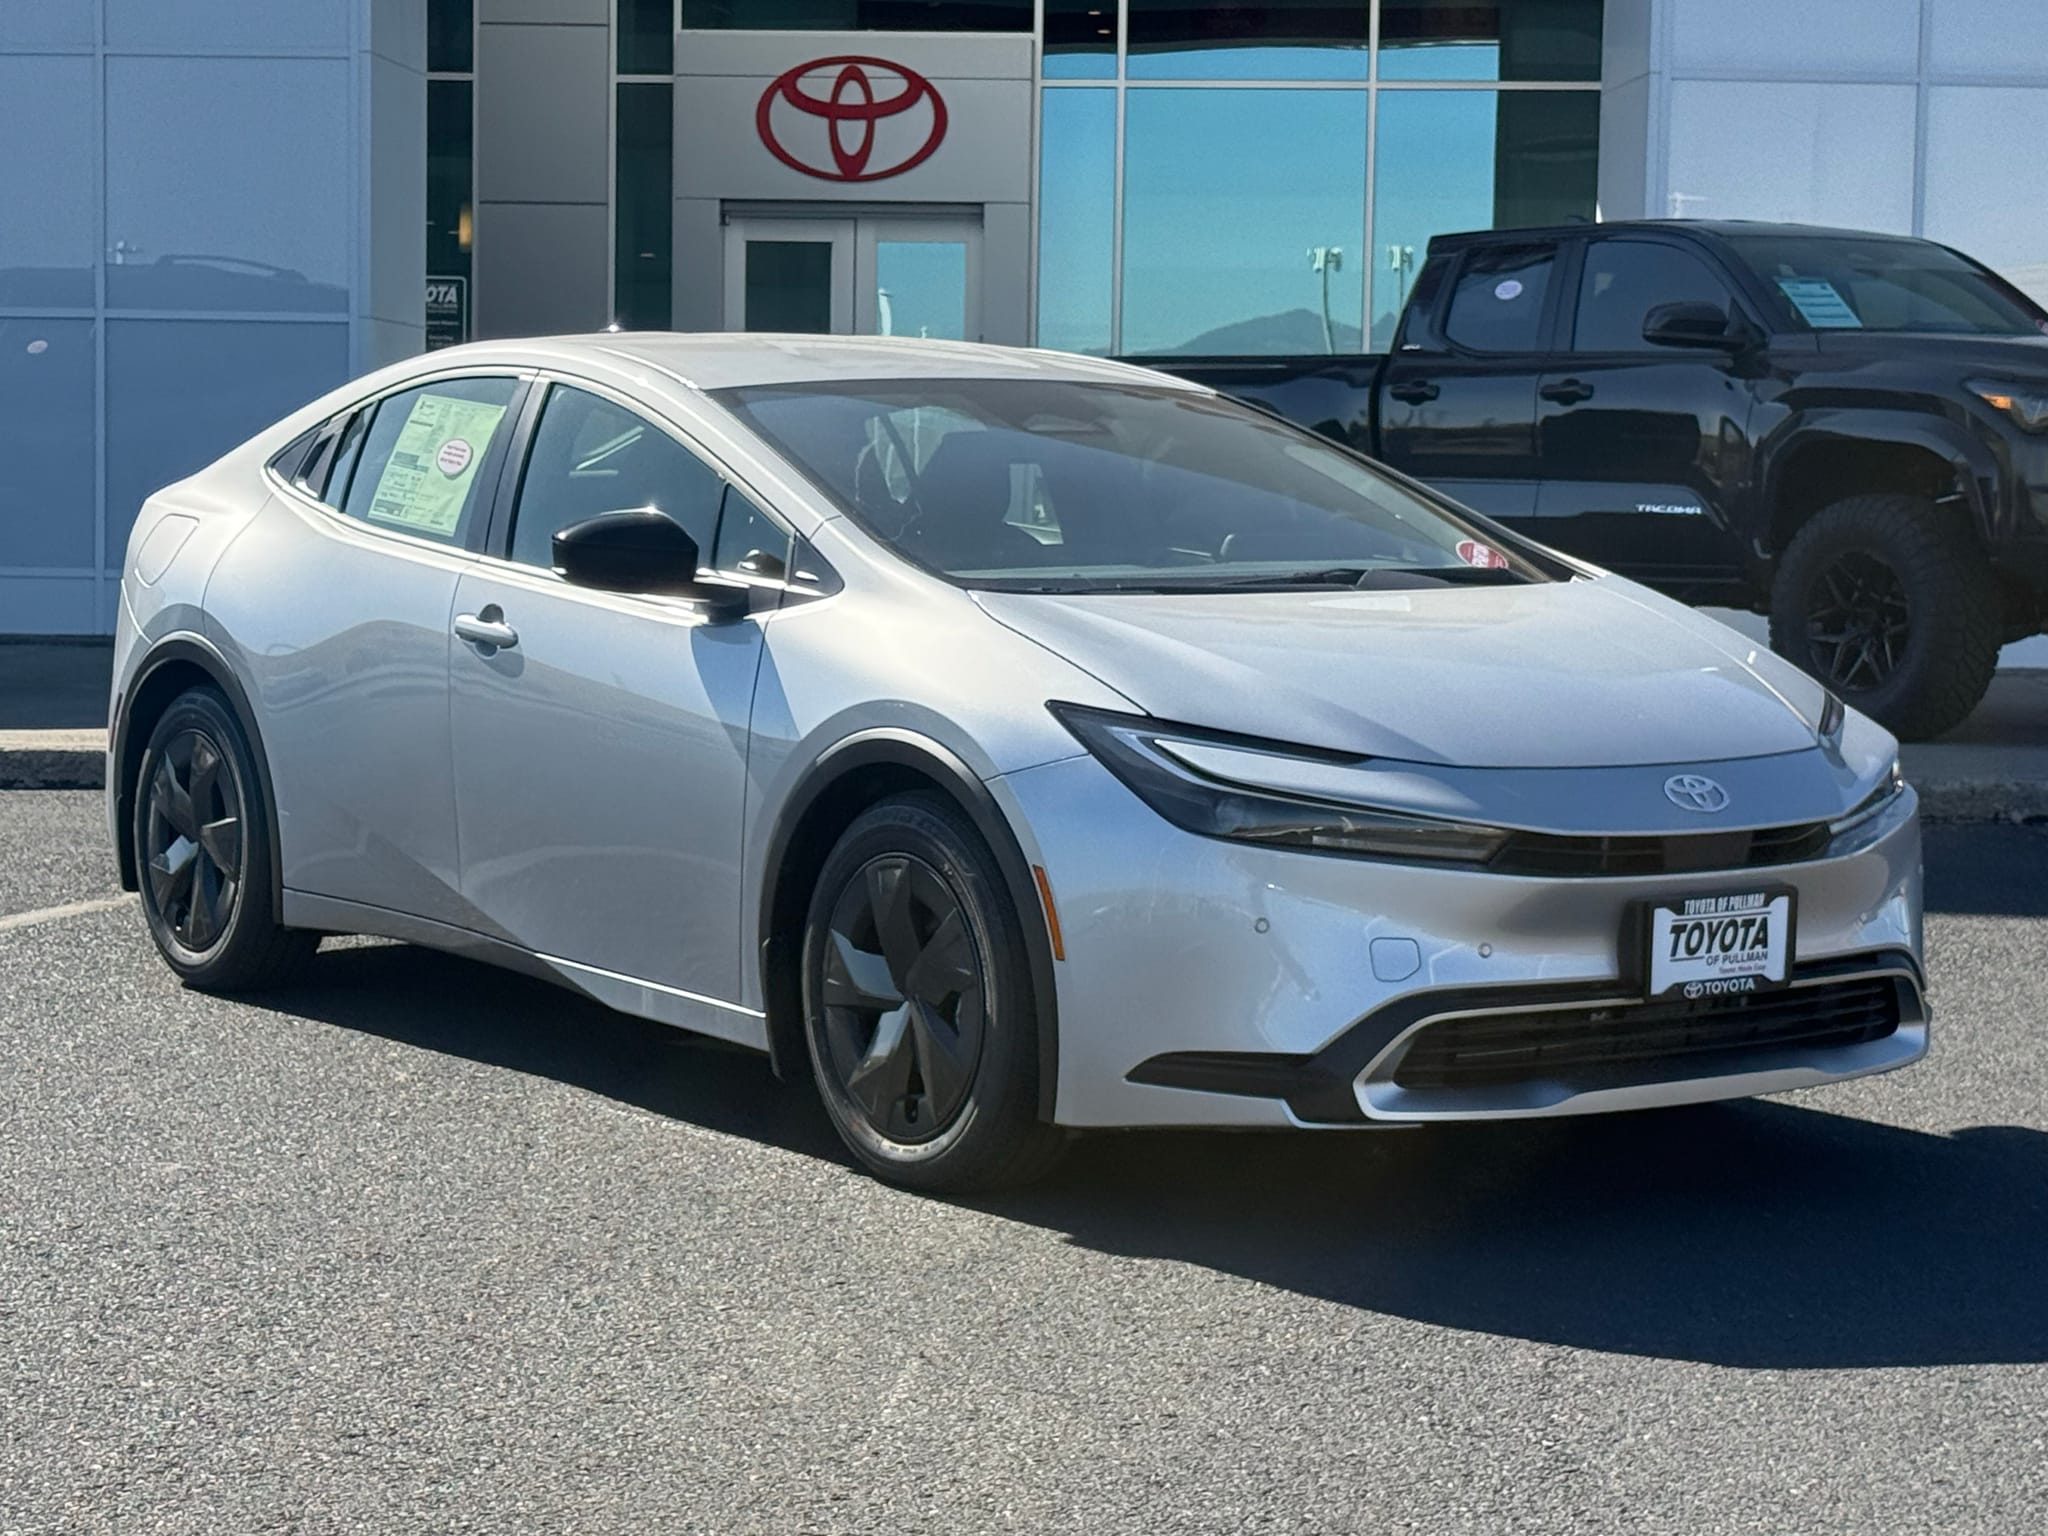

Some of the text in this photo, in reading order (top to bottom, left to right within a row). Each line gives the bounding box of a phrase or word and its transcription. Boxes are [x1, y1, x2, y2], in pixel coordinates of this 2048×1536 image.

[426, 285, 457, 303] OTA
[1635, 504, 1702, 514] TACOMA
[1684, 893, 1766, 914] TOYOTA OF PULLMAN
[1670, 917, 1768, 957] TOYOTA
[1706, 951, 1768, 966] OF PULLMAN
[1704, 978, 1755, 994] TOYOTA
